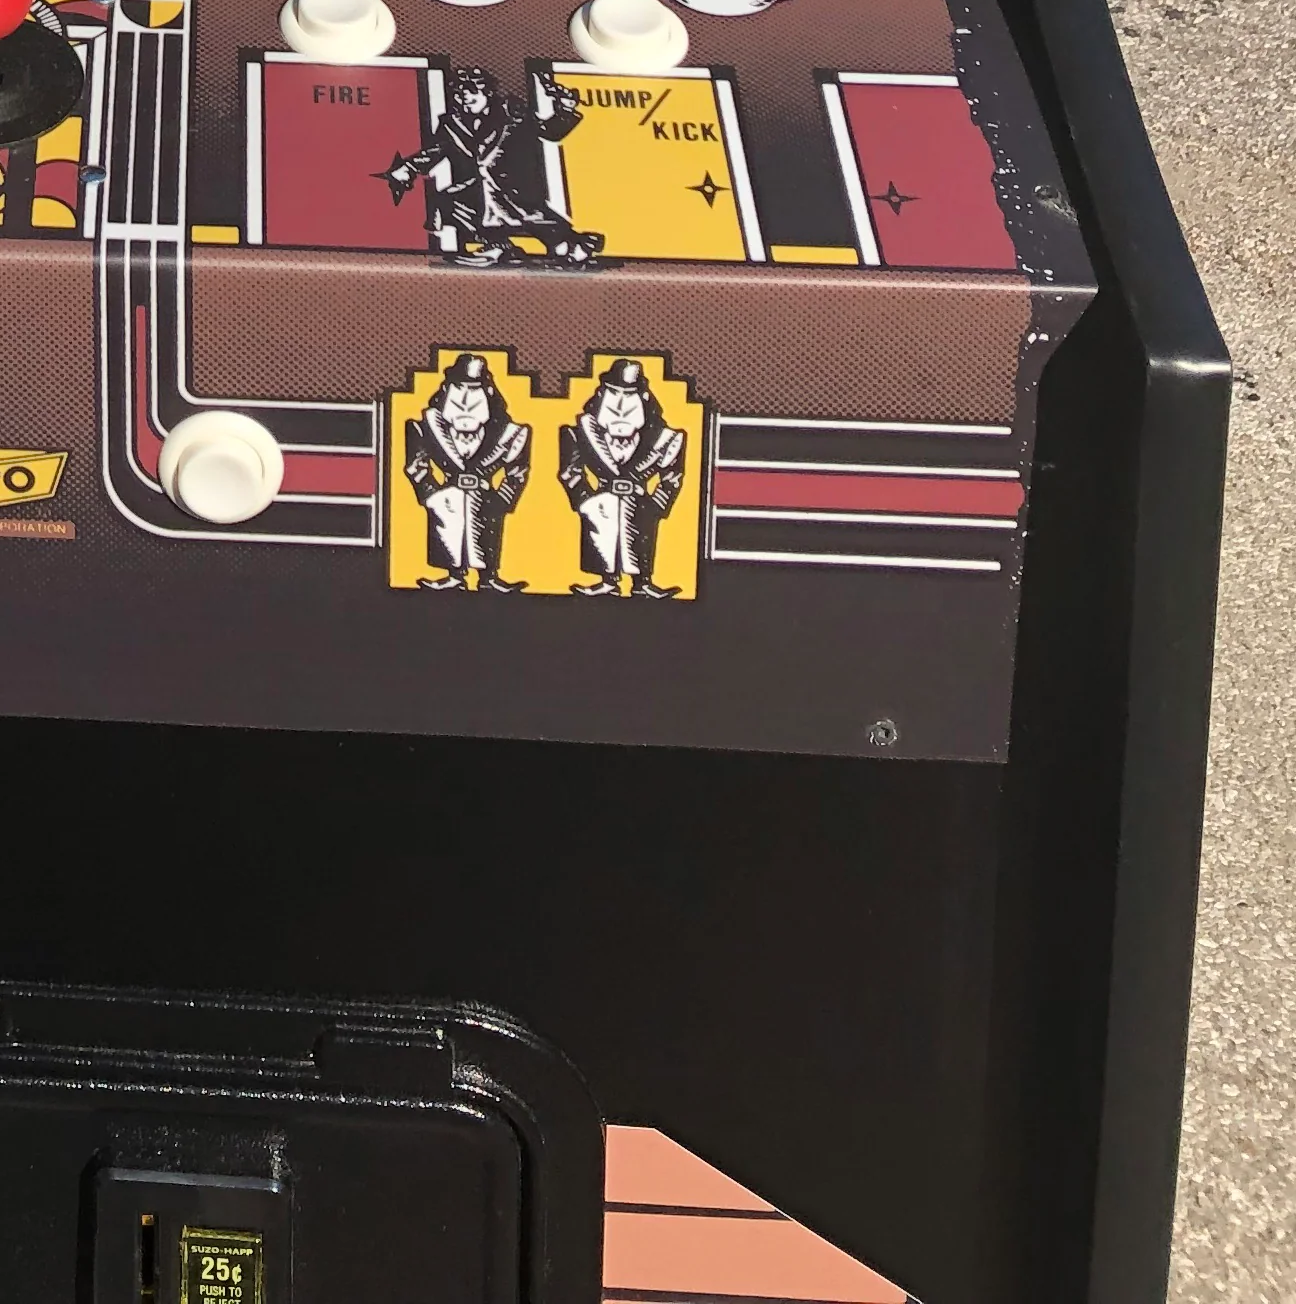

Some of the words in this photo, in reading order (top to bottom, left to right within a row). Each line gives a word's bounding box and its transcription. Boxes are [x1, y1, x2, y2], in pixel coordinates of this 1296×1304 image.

[313, 85, 371, 106] FIRE
[652, 120, 719, 142] KICK
[201, 1256, 242, 1285] 25¢
[200, 1284, 226, 1296] PUSH
[228, 1286, 242, 1298] TO
